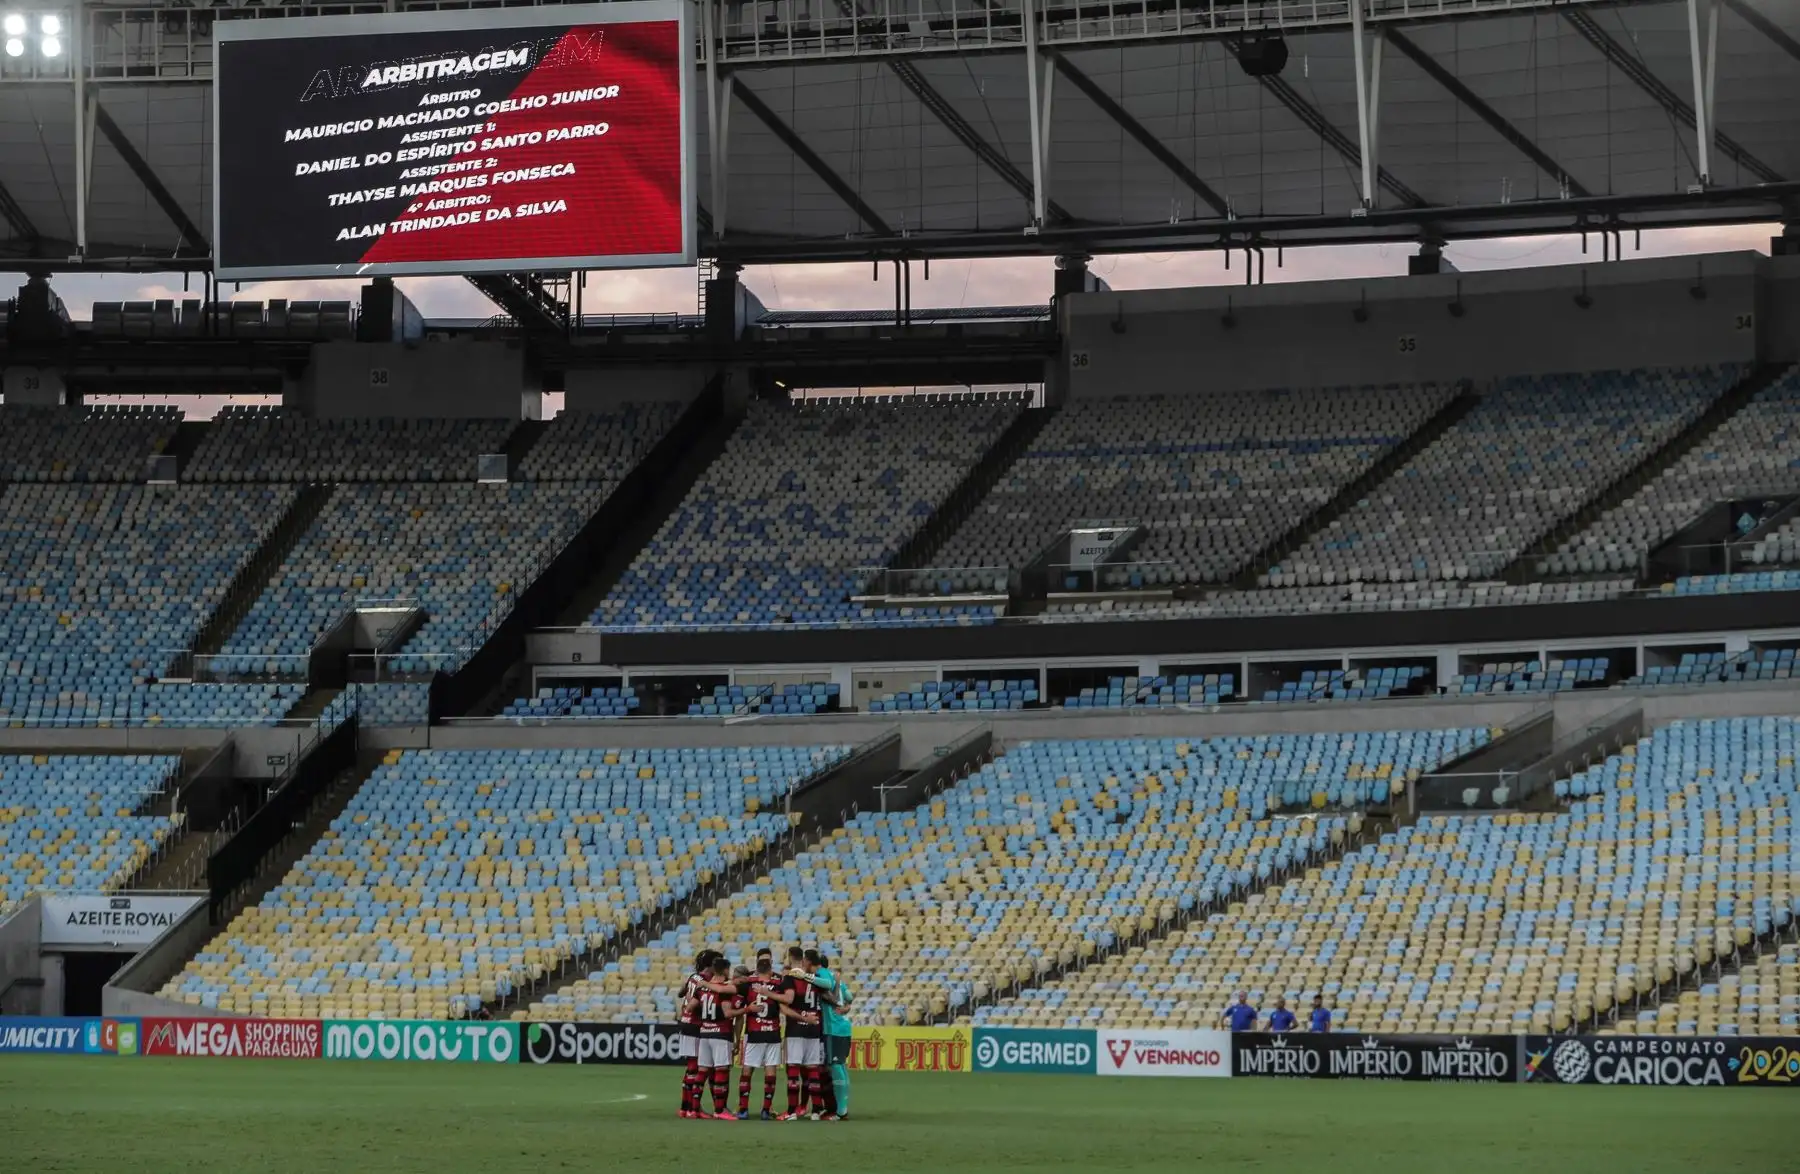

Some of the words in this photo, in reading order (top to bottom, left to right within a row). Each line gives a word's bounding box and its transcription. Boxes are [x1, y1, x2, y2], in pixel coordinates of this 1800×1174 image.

[361, 48, 529, 88] ARBITRAGEM
[418, 88, 481, 106] ÁRBITRO
[284, 119, 374, 142] MAURICIO
[377, 106, 470, 130] MACHADO
[473, 95, 548, 116] COELHO
[550, 85, 619, 106] JUNIOR
[400, 123, 483, 144] ASSISTENTE
[486, 122, 496, 133] 1:
[295, 156, 360, 176] DANIEL
[364, 151, 392, 166] DO
[395, 140, 477, 162] ESPÍRITO
[480, 131, 542, 151] SANTO
[545, 122, 609, 142] PARRO
[399, 159, 482, 179] ASSISTENTE
[485, 157, 498, 169] 2:
[328, 186, 396, 206] THAYSE
[399, 174, 487, 198] MARQUES
[491, 162, 576, 185] FONSECA
[424, 194, 491, 212] ÁRBITRO:
[336, 222, 386, 241] ALAN
[389, 210, 482, 234] TRINDADE
[485, 207, 511, 221] DA
[515, 199, 568, 217] SILVA
[1735, 315, 1752, 330] 34
[1399, 338, 1416, 352] 35
[1073, 353, 1088, 367] 36
[24, 376, 39, 390] 39
[372, 370, 388, 384] 38
[66, 911, 121, 926] AZEITE
[700, 993, 717, 1020] 14
[804, 983, 815, 1009] 4
[176, 1022, 243, 1055] MEGA
[245, 1023, 318, 1042] SHOPPING
[245, 1041, 318, 1057] PARAGUAY
[558, 1023, 682, 1065] Sportsbe
[1003, 1041, 1091, 1066] GERMED
[1594, 1040, 1726, 1054] CAMPEONATO
[1134, 1049, 1221, 1066] VENANCIO
[1738, 1046, 1800, 1083] 2020
[1594, 1056, 1725, 1085] CARIOCA
